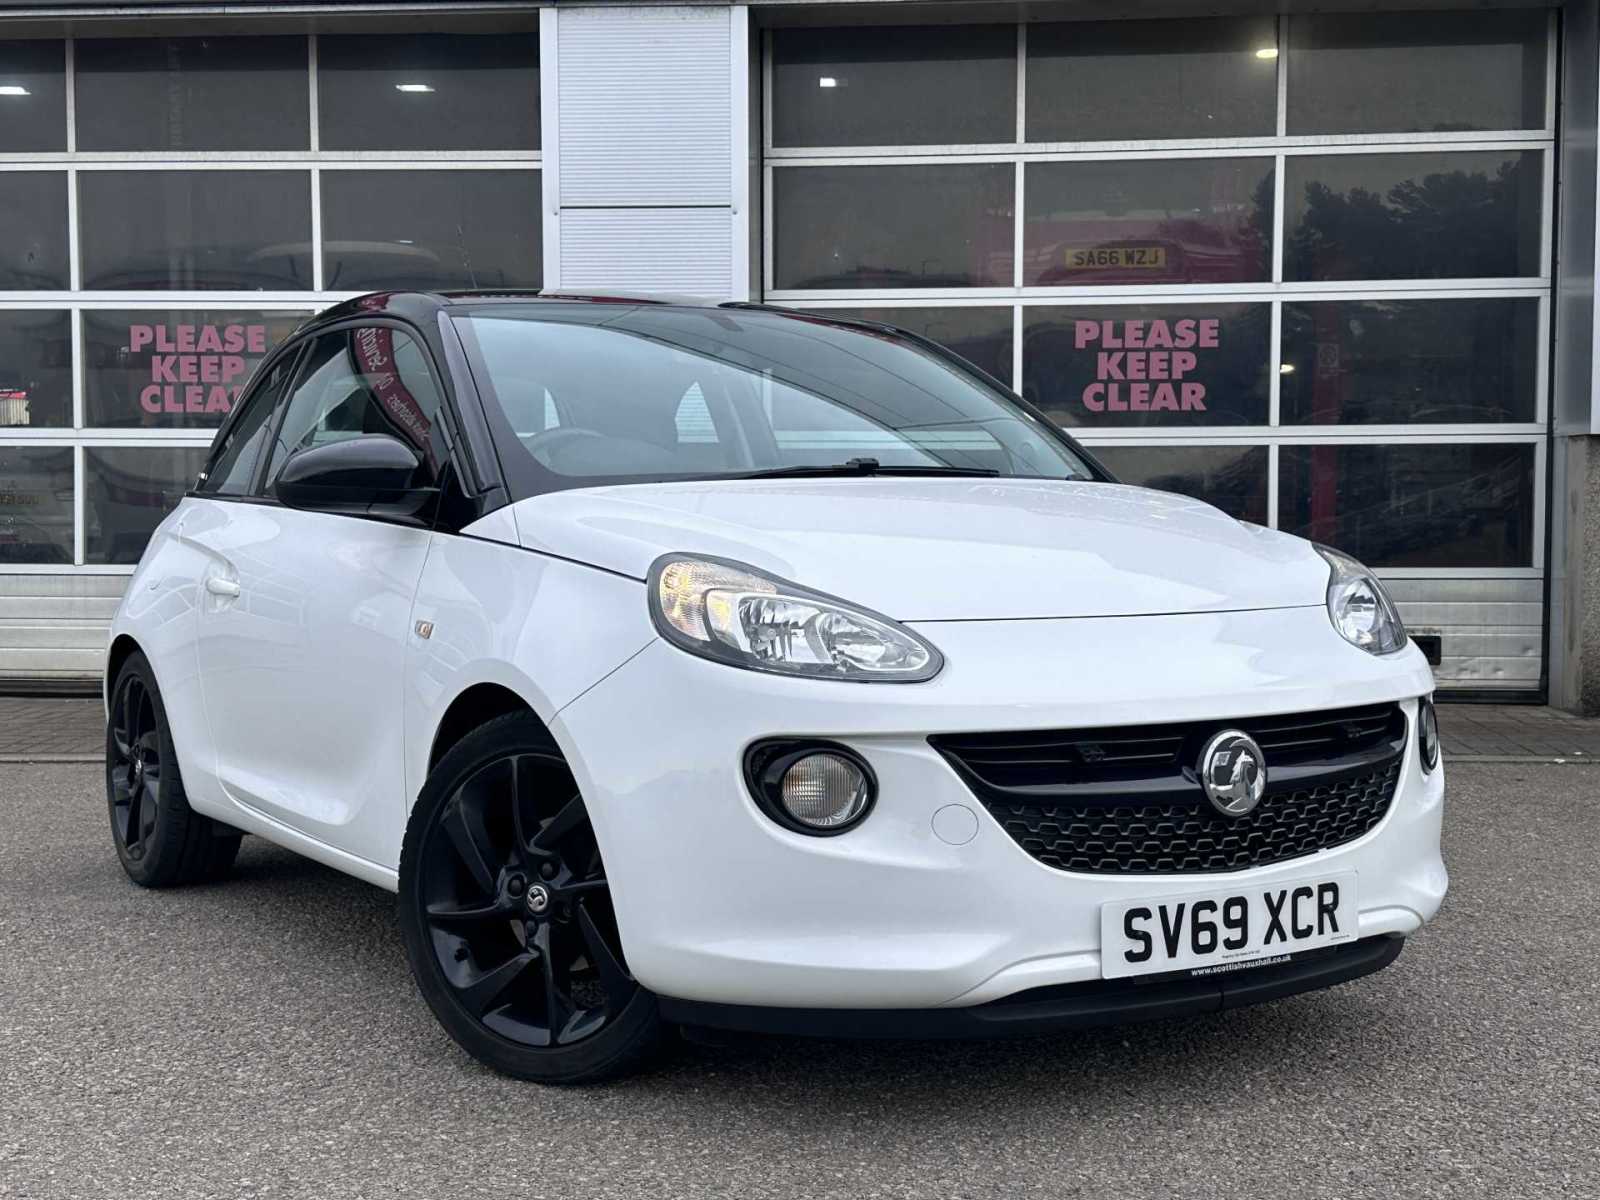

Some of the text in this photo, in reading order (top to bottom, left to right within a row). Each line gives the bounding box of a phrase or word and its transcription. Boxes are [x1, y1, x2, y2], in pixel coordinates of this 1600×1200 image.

[1073, 249, 1159, 266] SA66 WZJ
[130, 325, 266, 353] PLEASE
[1075, 319, 1219, 348] PLEASE
[152, 355, 246, 382] KEEP
[1097, 351, 1197, 380] KEEP
[140, 385, 242, 413] CLEA
[1082, 383, 1207, 411] CLEAR
[1124, 882, 1339, 963] SV69 XCR
[1191, 954, 1291, 976] www.scottishvauxhall.co.uk
